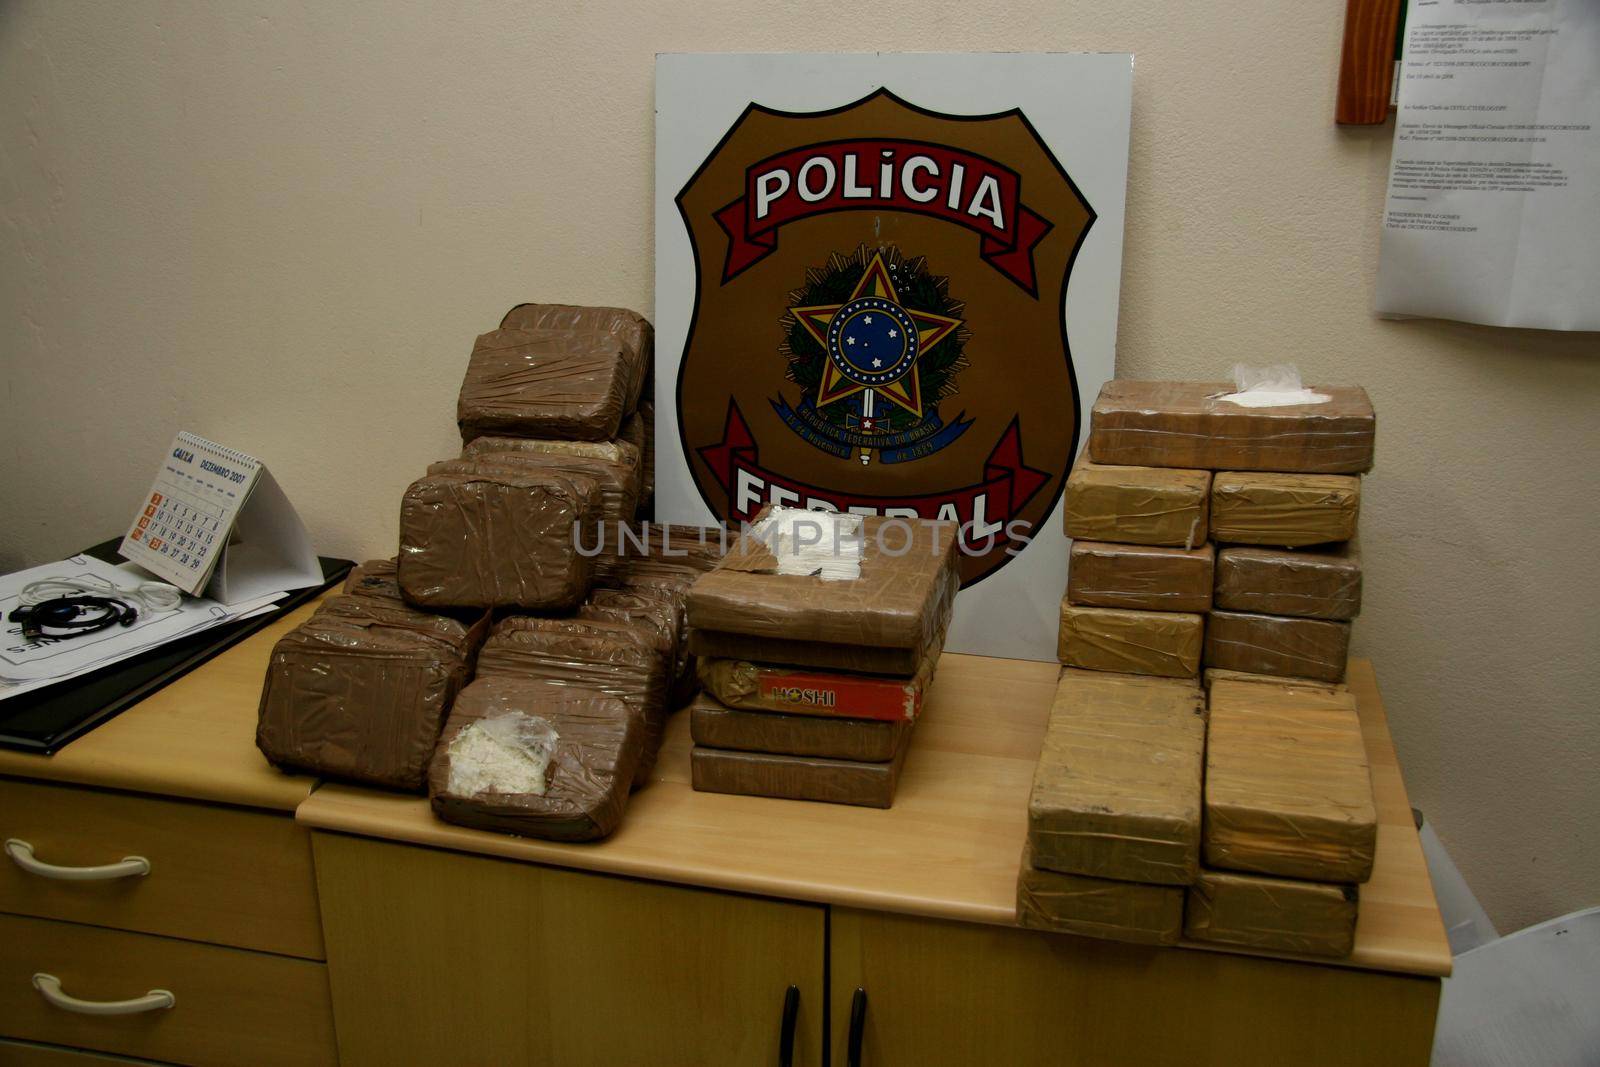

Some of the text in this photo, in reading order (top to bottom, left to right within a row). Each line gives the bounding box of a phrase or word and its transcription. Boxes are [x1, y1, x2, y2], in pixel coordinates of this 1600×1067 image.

[909, 422, 937, 441] BRASIL
[172, 447, 194, 464] CAIXA
[199, 459, 246, 485] DEZEMBRO 2007
[772, 687, 836, 708] HOSHI
